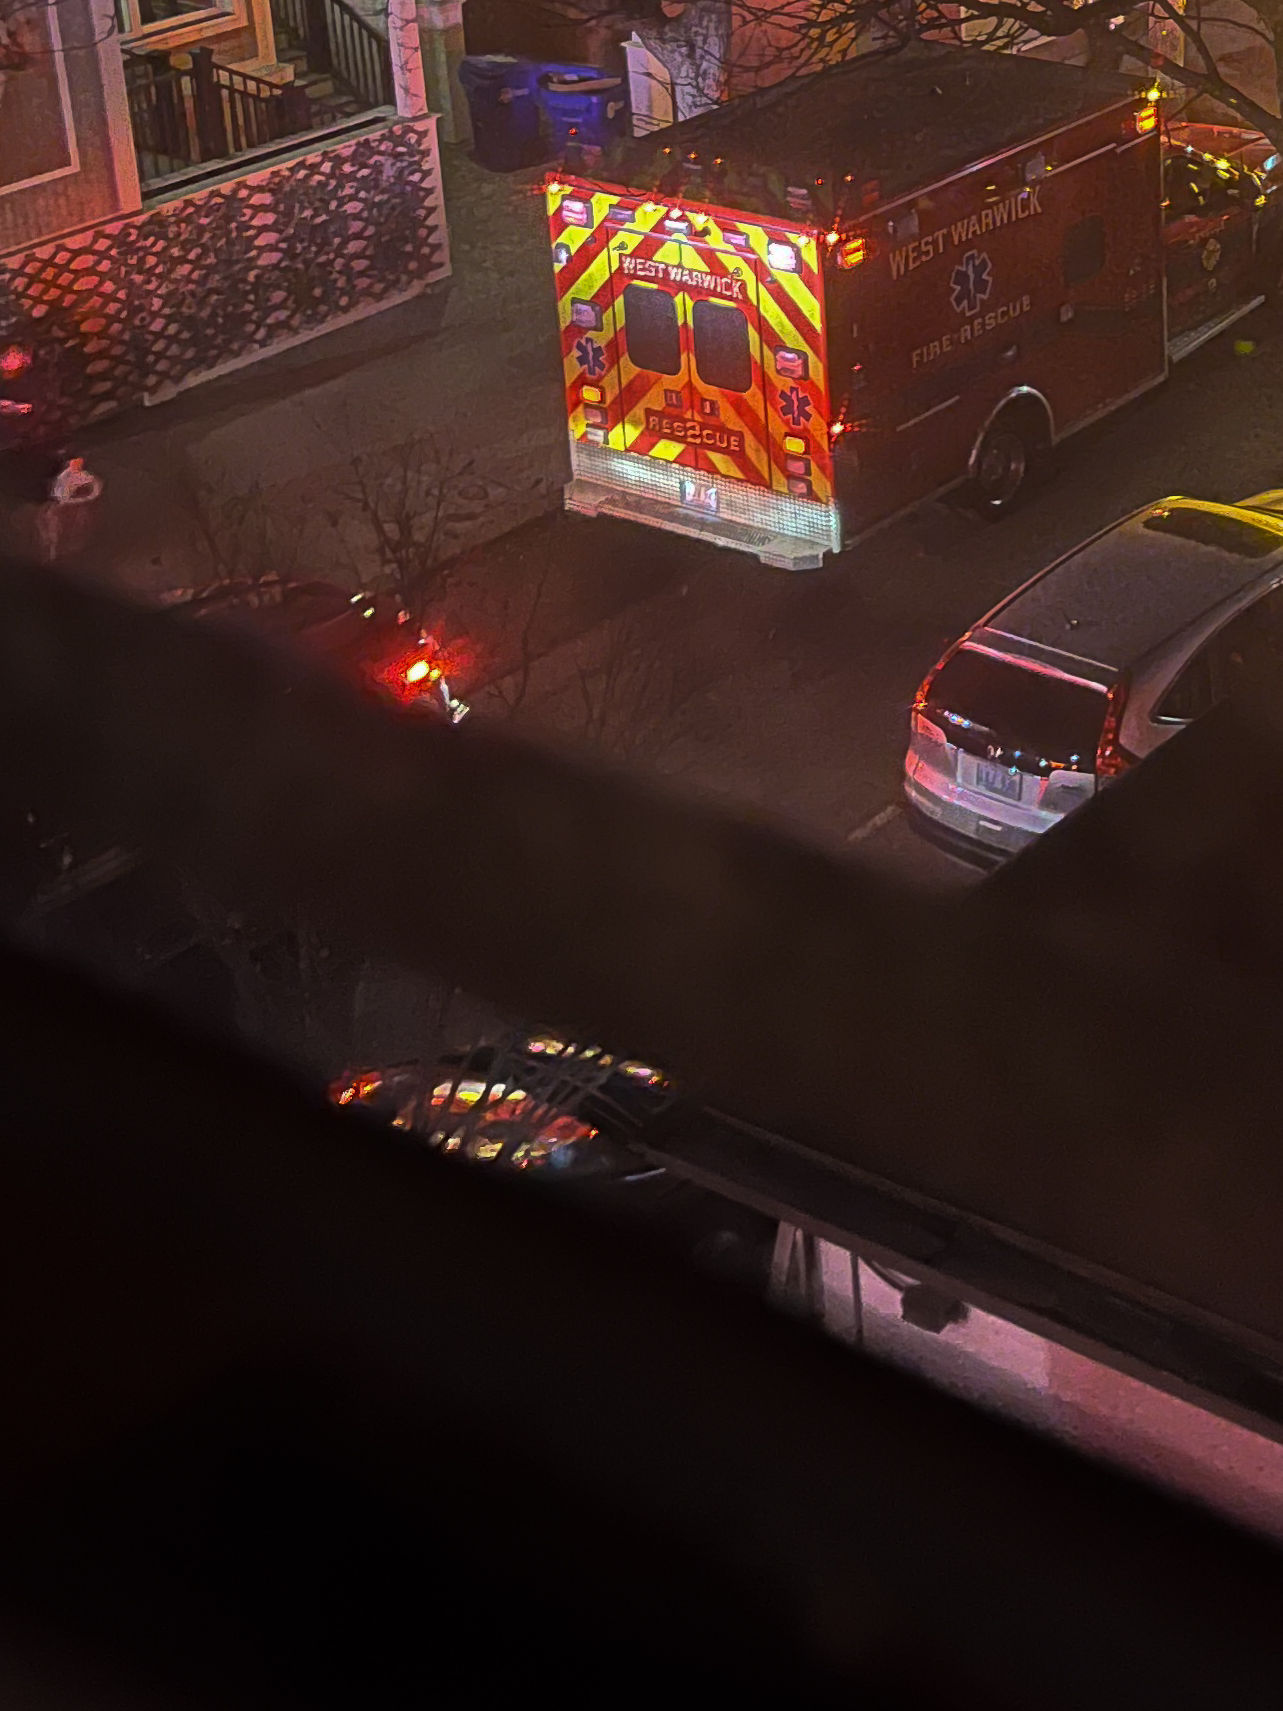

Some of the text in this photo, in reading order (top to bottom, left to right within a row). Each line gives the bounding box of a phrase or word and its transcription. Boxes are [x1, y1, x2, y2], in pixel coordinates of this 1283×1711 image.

[889, 185, 1042, 280] WEST WARWICK
[622, 256, 743, 300] WEST WARWICK
[912, 294, 1031, 369] FIRE RESCUE
